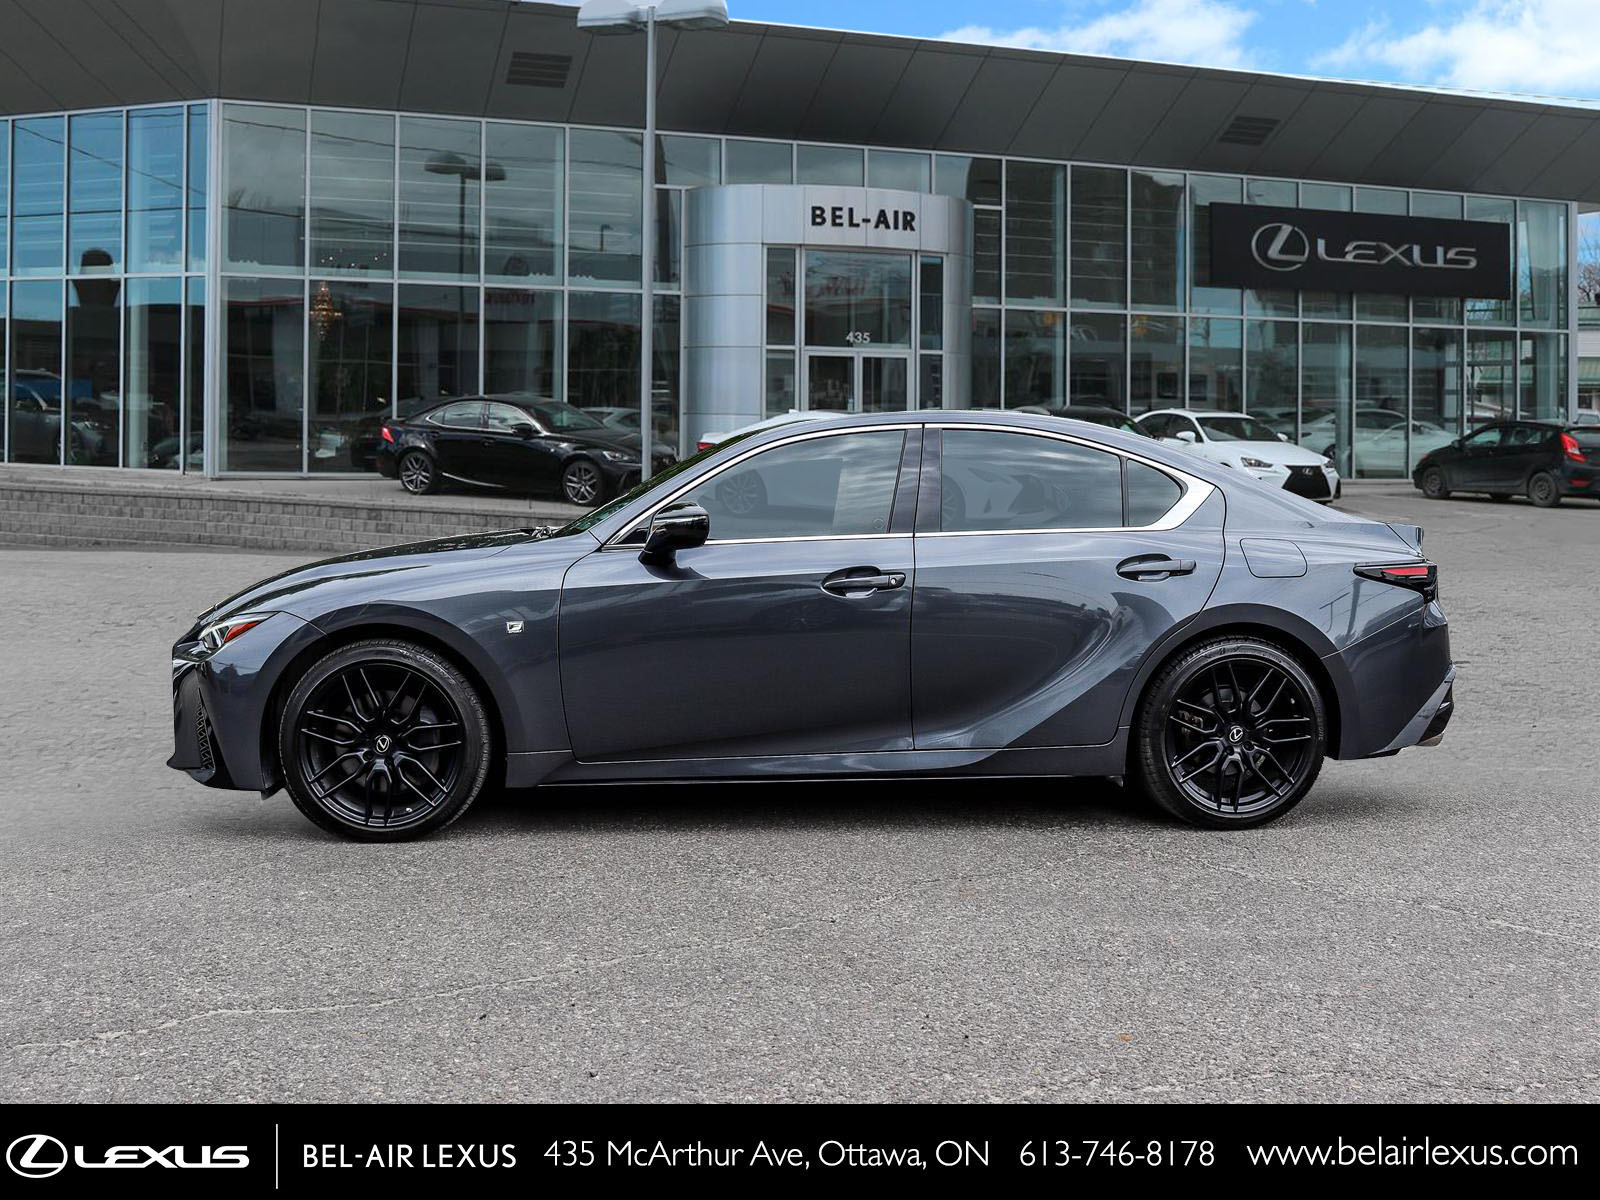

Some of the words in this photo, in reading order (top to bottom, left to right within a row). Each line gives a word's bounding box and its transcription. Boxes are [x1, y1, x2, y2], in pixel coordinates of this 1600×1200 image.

[811, 205, 916, 231] BEL-AIR
[1317, 237, 1478, 269] LEXUS
[845, 331, 871, 344] 435
